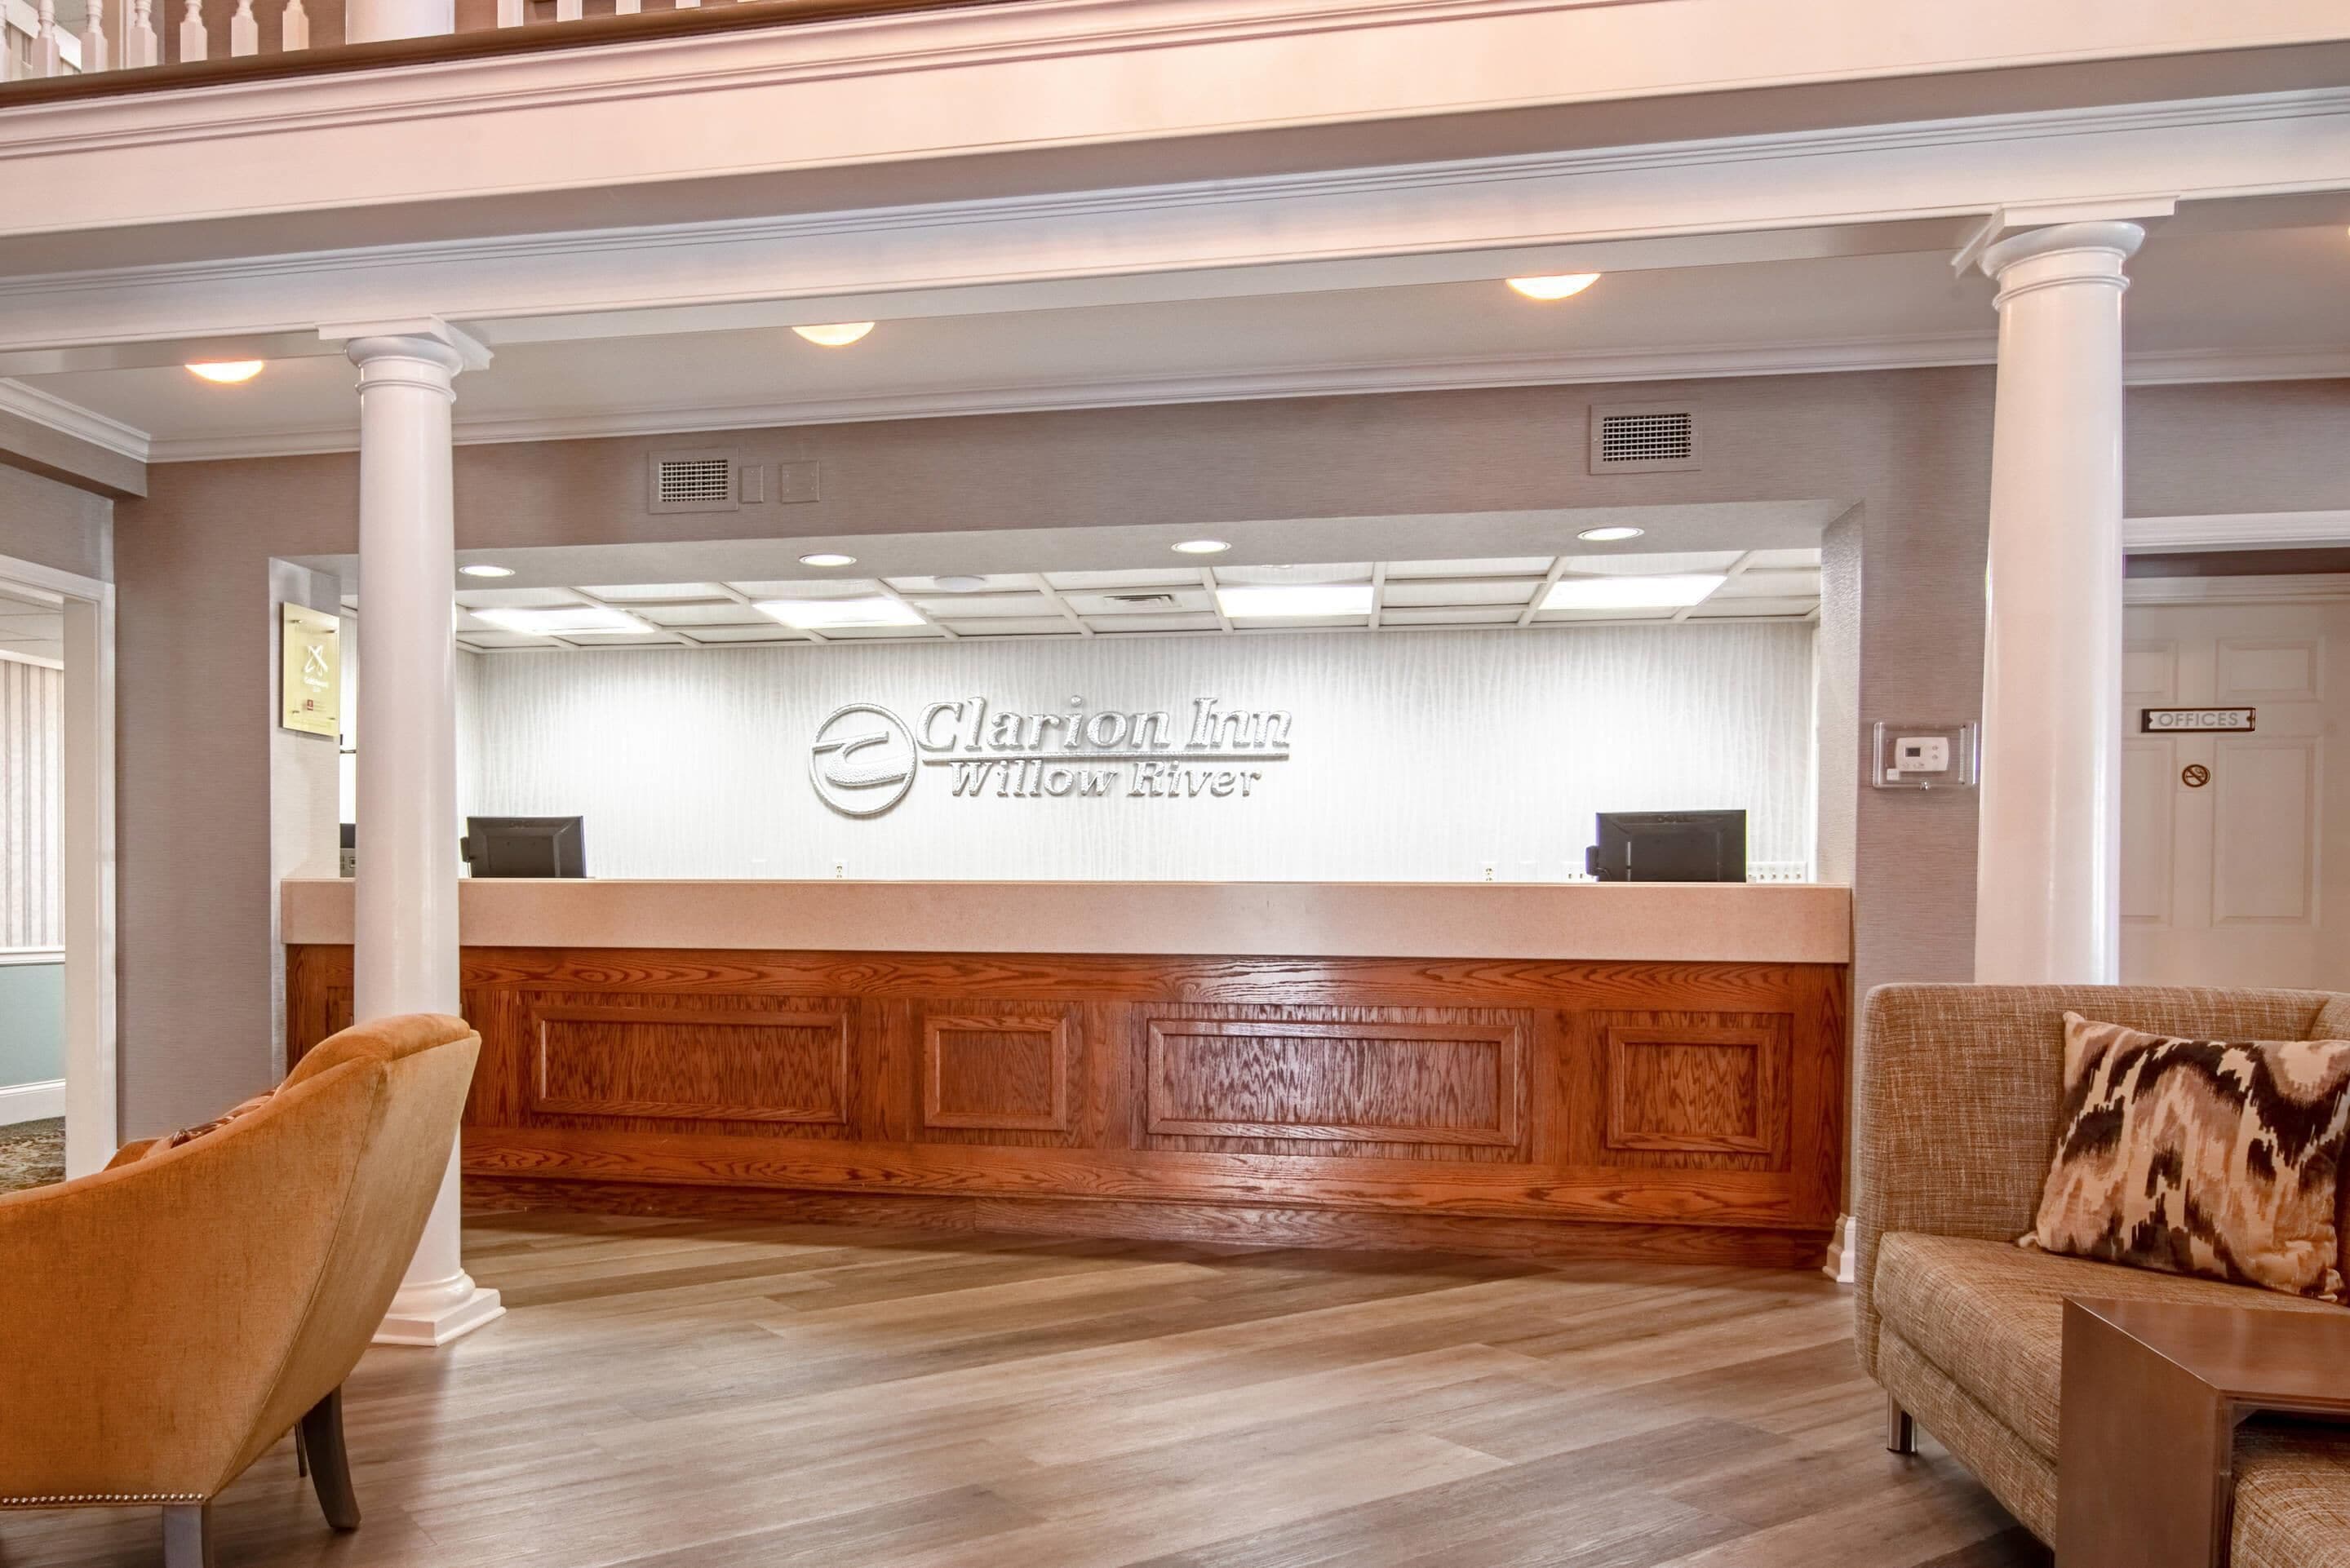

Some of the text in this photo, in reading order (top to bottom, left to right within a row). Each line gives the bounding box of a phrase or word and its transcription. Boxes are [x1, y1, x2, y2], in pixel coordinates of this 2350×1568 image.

[916, 695, 1292, 751] Clarion Inn
[2158, 712, 2238, 727] OFFICES
[949, 760, 1262, 798] Willow River
